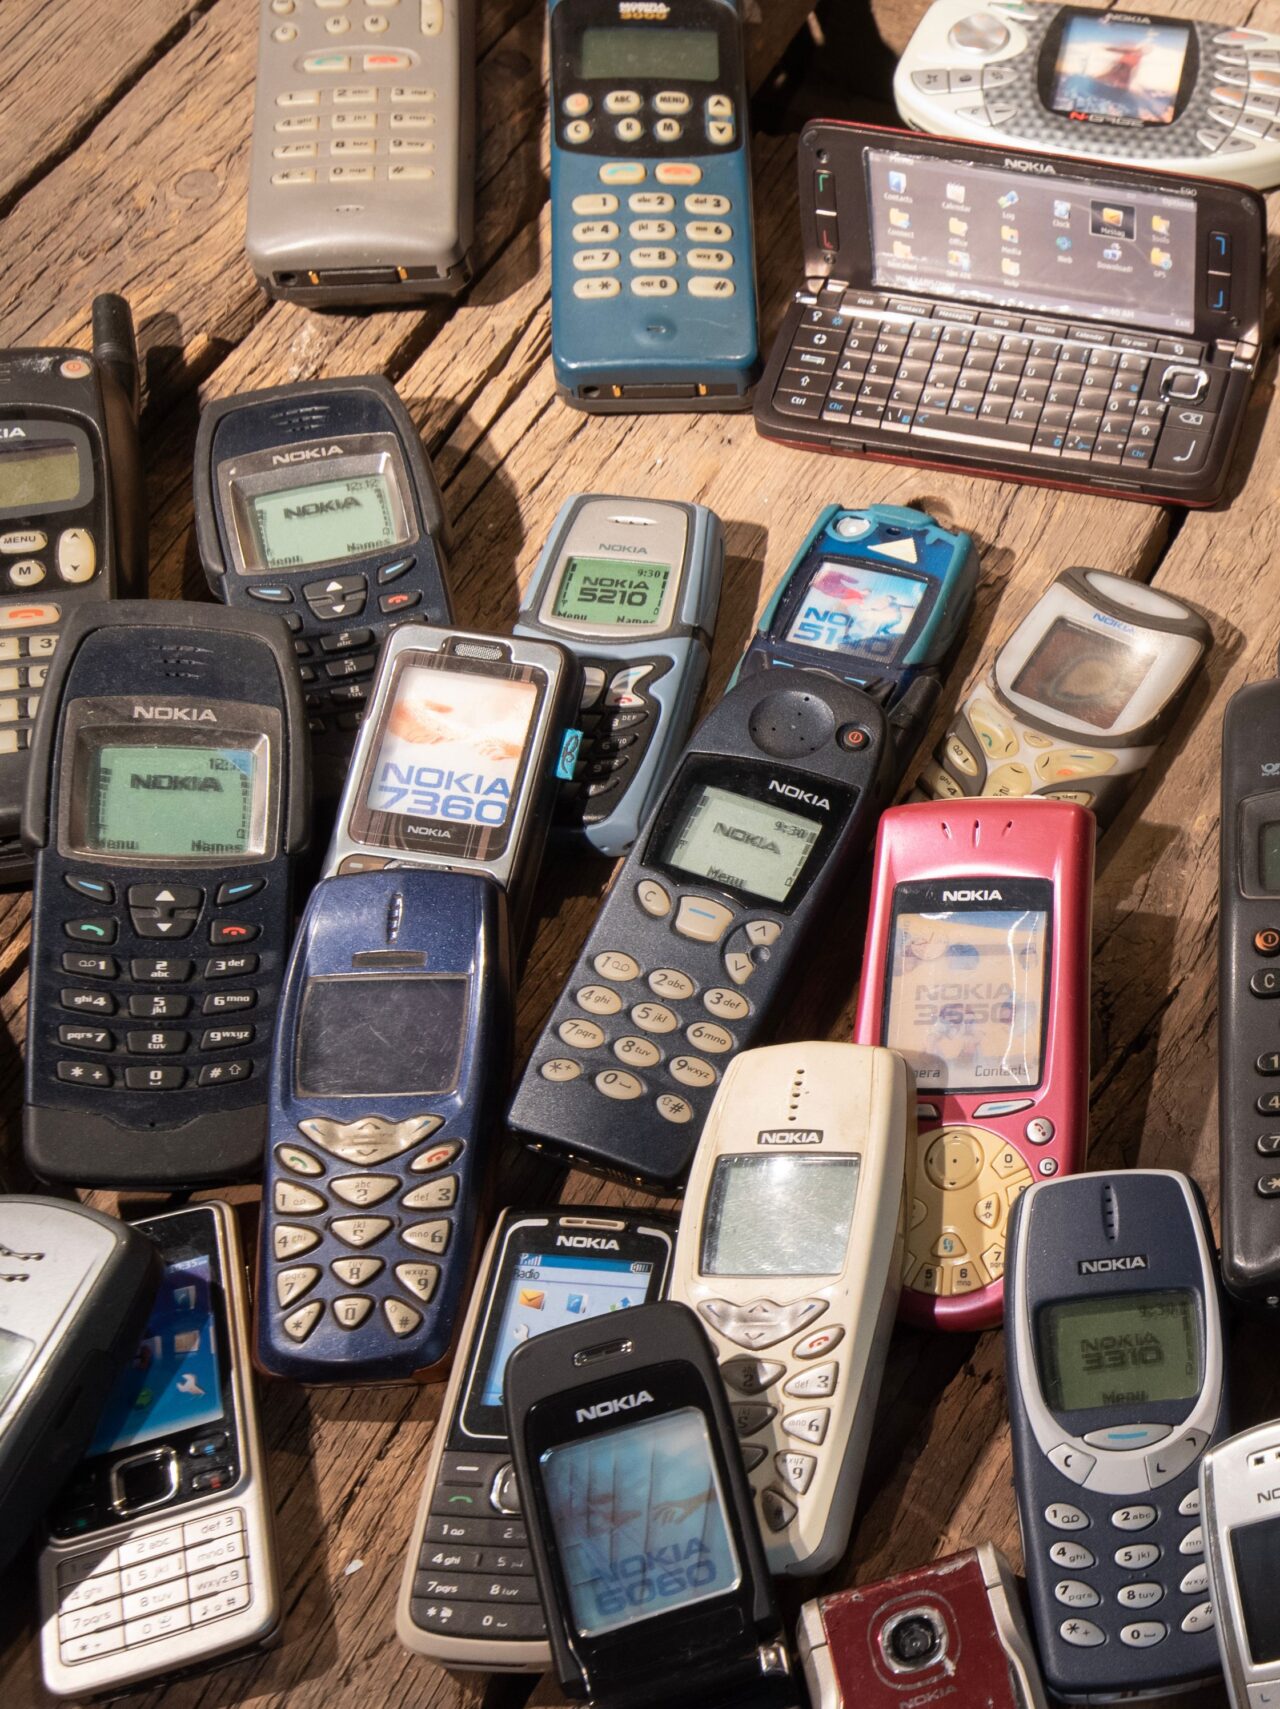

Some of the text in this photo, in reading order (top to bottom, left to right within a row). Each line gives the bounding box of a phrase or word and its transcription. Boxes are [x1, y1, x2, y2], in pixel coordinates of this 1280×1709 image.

[659, 96, 685, 104] MENU
[1004, 157, 1057, 175] NOKIA
[791, 394, 807, 406] Ctrl
[272, 444, 345, 466] NOKIA
[283, 496, 362, 521] NOKIA
[3, 535, 37, 545] MENU
[599, 543, 649, 556] NOKIA
[18, 565, 32, 576] M
[637, 568, 662, 579] 9:30
[582, 576, 650, 591] NOKIA
[577, 587, 649, 607] 5210
[1092, 612, 1137, 635] NOKIA
[133, 704, 218, 723] NOKIA
[129, 772, 225, 794] NOKIA
[380, 762, 512, 799] NOKIA
[769, 779, 832, 812] NOKIA
[378, 785, 509, 826] 7360
[407, 824, 452, 840] NOKIA
[712, 821, 783, 856] NOKIA
[190, 839, 244, 855] Names
[706, 863, 747, 888] Menu
[943, 889, 1003, 902] NOKIA
[914, 982, 1015, 1001] NOKIA
[975, 1064, 1031, 1078] Contacts
[761, 1130, 822, 1144] NOKIA
[556, 1235, 621, 1251] NOKIA
[1081, 1256, 1147, 1274] NOKIA
[1080, 1331, 1162, 1350] NOKIA
[1082, 1346, 1164, 1375] 3310
[576, 1390, 655, 1424] NOKIA
[590, 1537, 712, 1588] NOKIA
[598, 1561, 718, 1615] 6060
